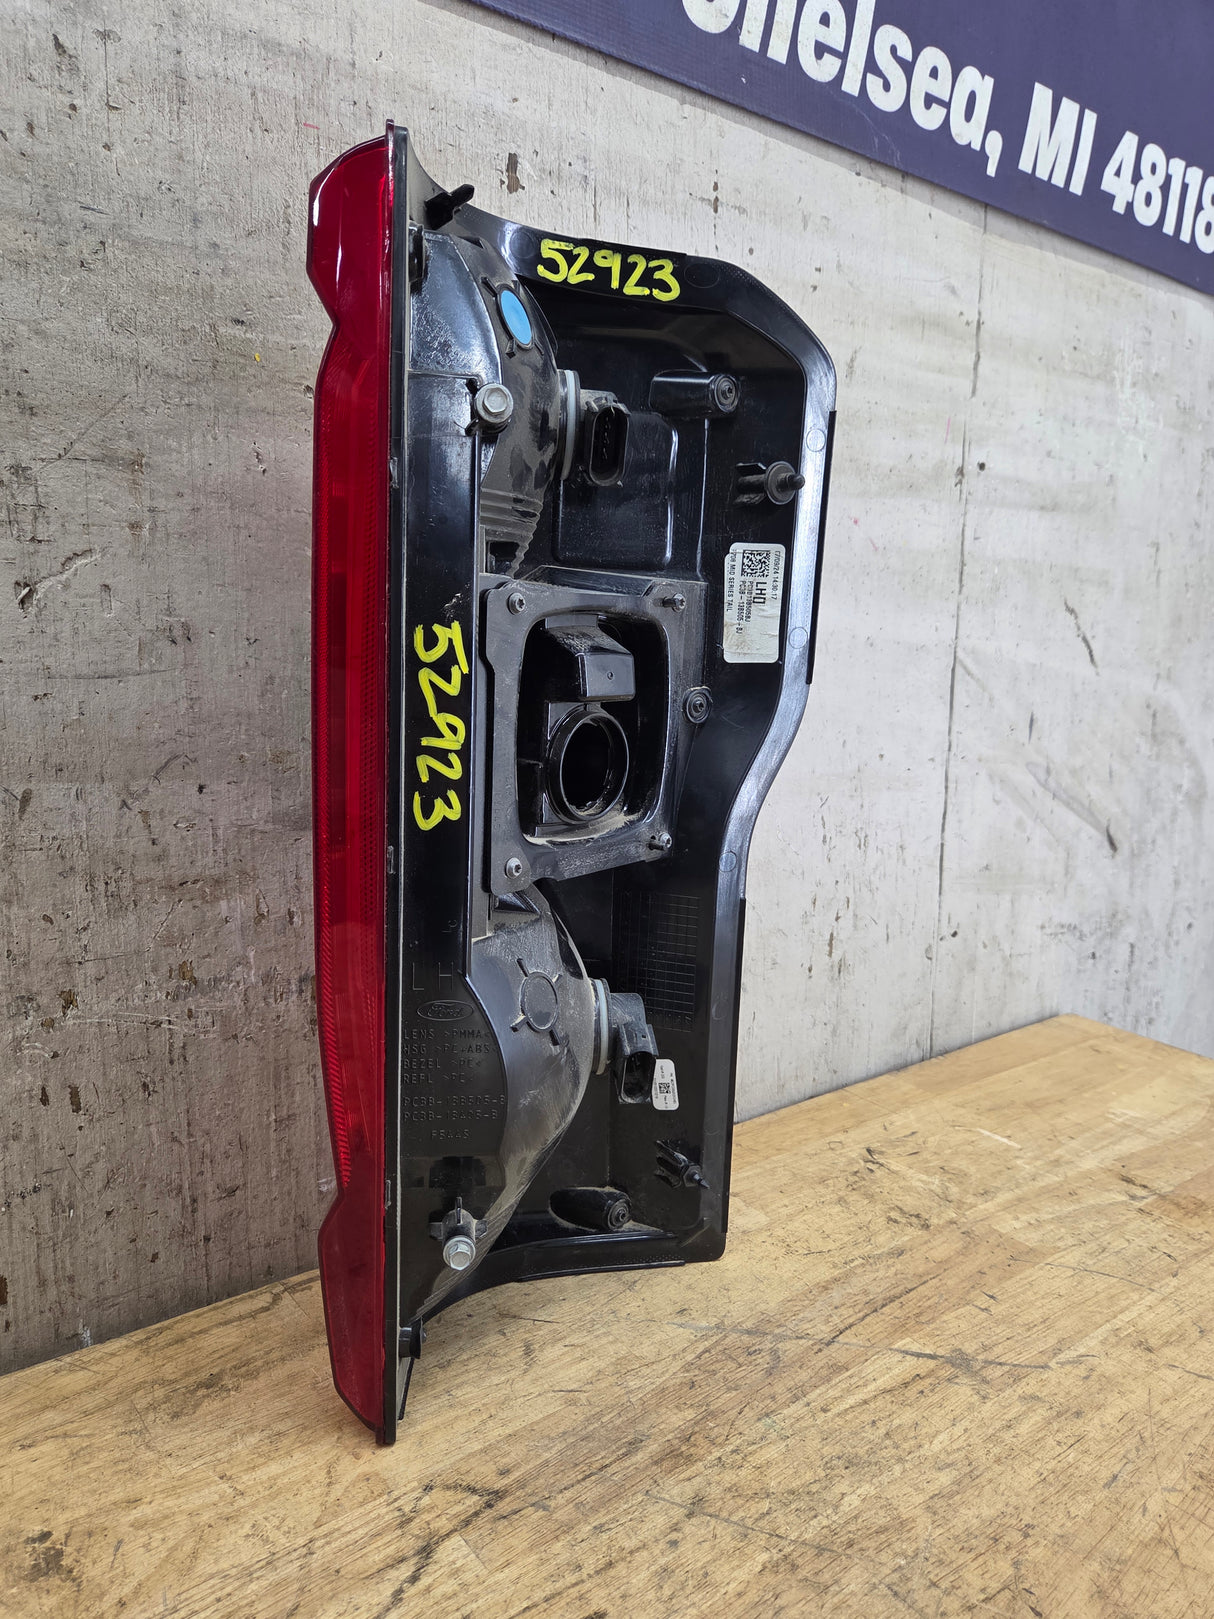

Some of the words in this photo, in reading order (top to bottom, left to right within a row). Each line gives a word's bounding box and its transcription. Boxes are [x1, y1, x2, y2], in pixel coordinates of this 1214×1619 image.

[1018, 82, 1097, 196] MI
[1101, 130, 1214, 254] 48118
[537, 239, 681, 301] 52923
[413, 620, 470, 831] 52923
[403, 1029, 435, 1040] LENS
[402, 1073, 433, 1084] REFL
[403, 1058, 441, 1069] BEZEL
